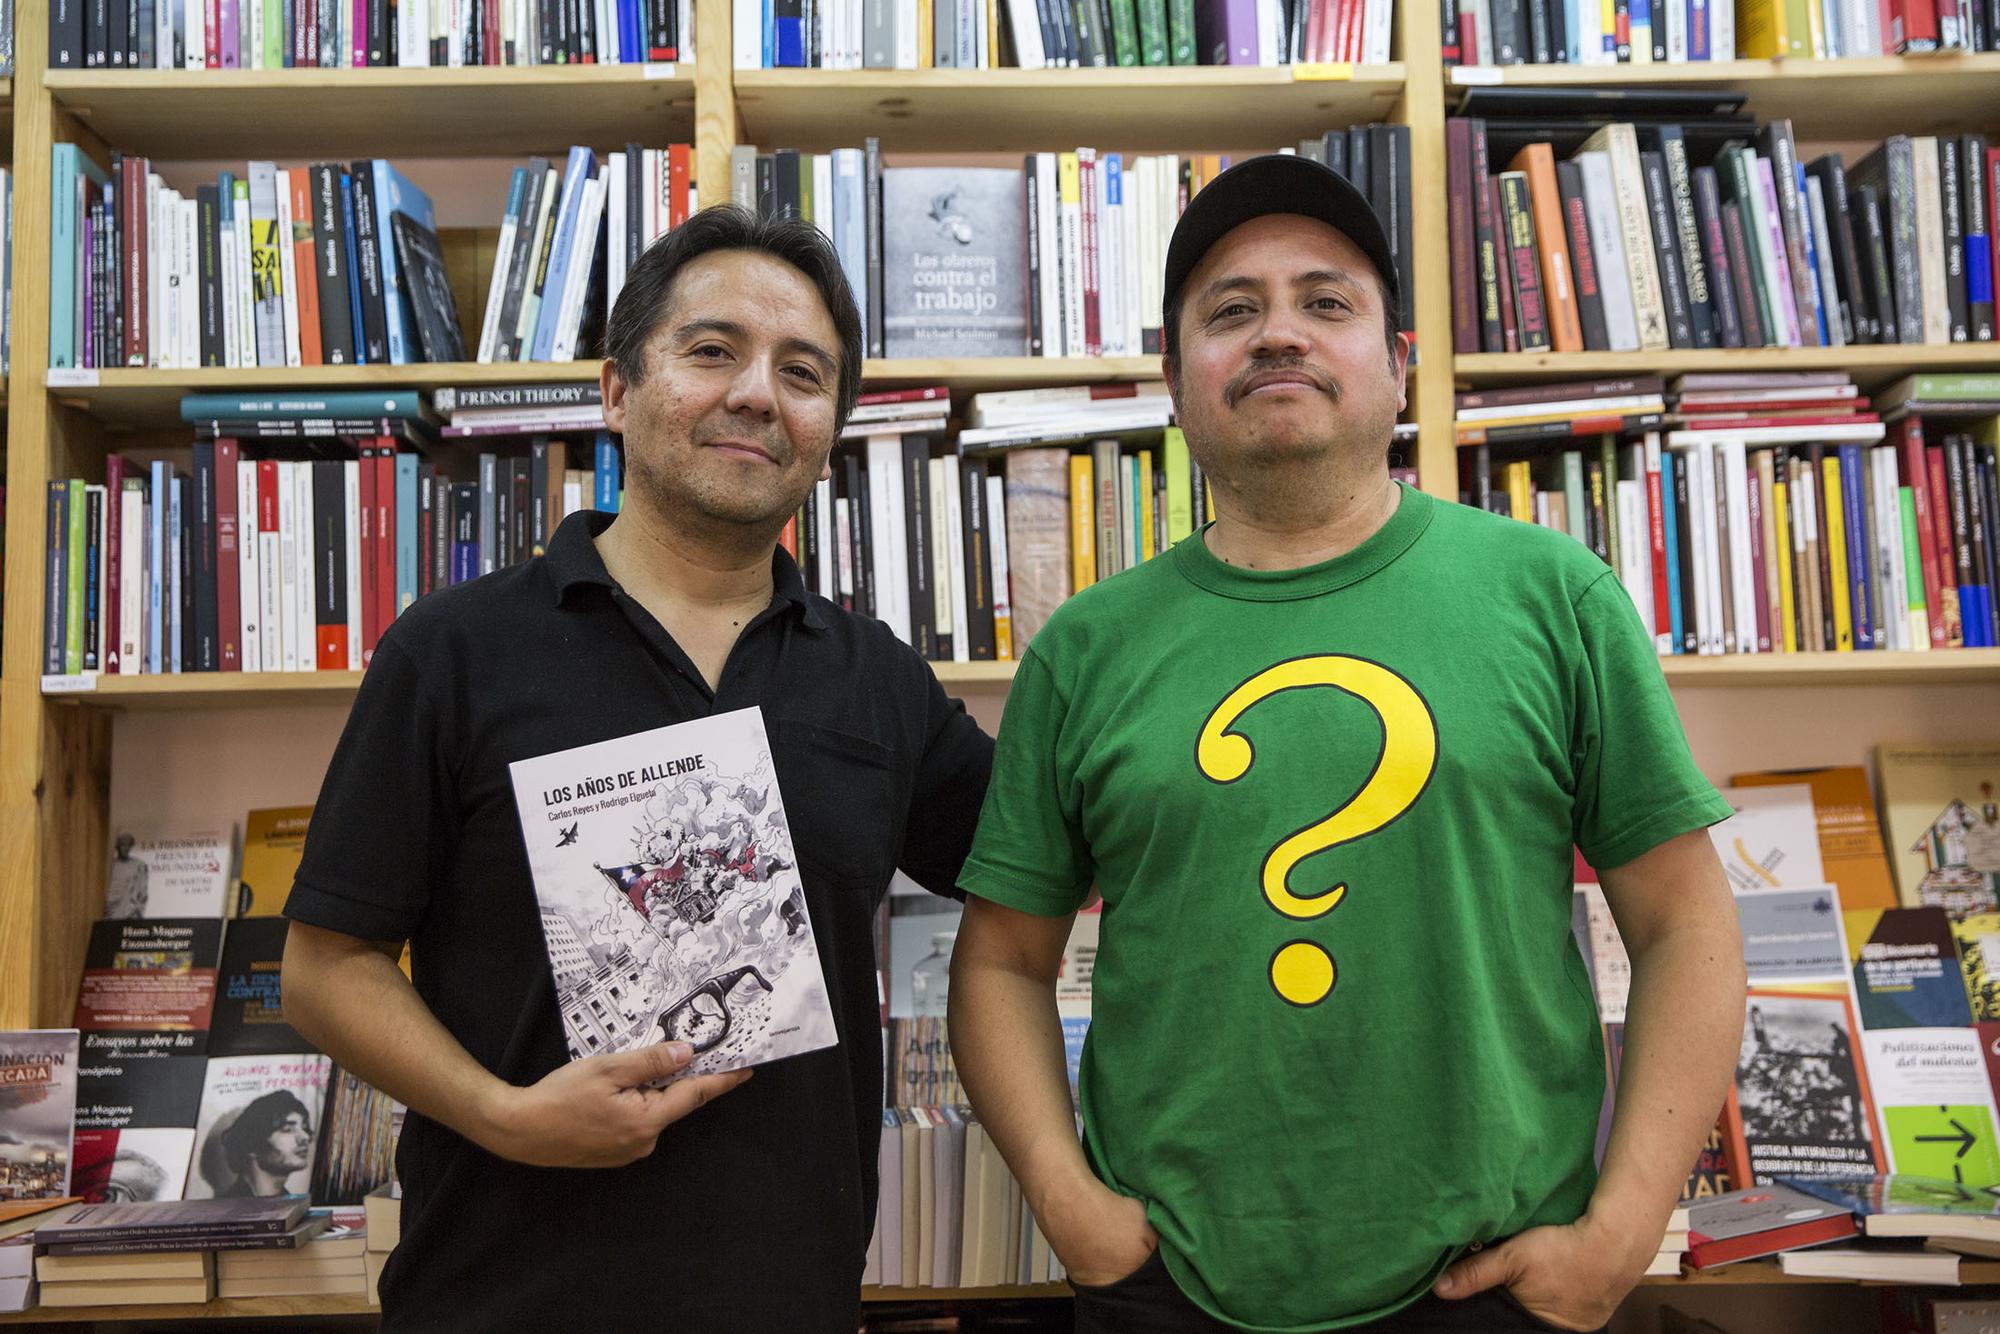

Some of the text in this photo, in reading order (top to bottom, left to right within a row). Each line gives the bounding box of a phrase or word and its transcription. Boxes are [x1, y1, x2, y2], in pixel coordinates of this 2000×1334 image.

[914, 252, 997, 268] Los obreros
[913, 265, 997, 287] contra el
[915, 285, 997, 315] trabajo
[460, 389, 521, 406] FRENCH
[525, 387, 583, 404] THEORY
[543, 754, 706, 806] LOS AÑOS DE ALLENDE
[548, 788, 656, 822] Carlos Reyes y Rodrigo Elgueta
[1194, 653, 1440, 1008] ?
[85, 1033, 195, 1051] Ensayos sobre las
[1895, 1058, 1979, 1069] del malestar
